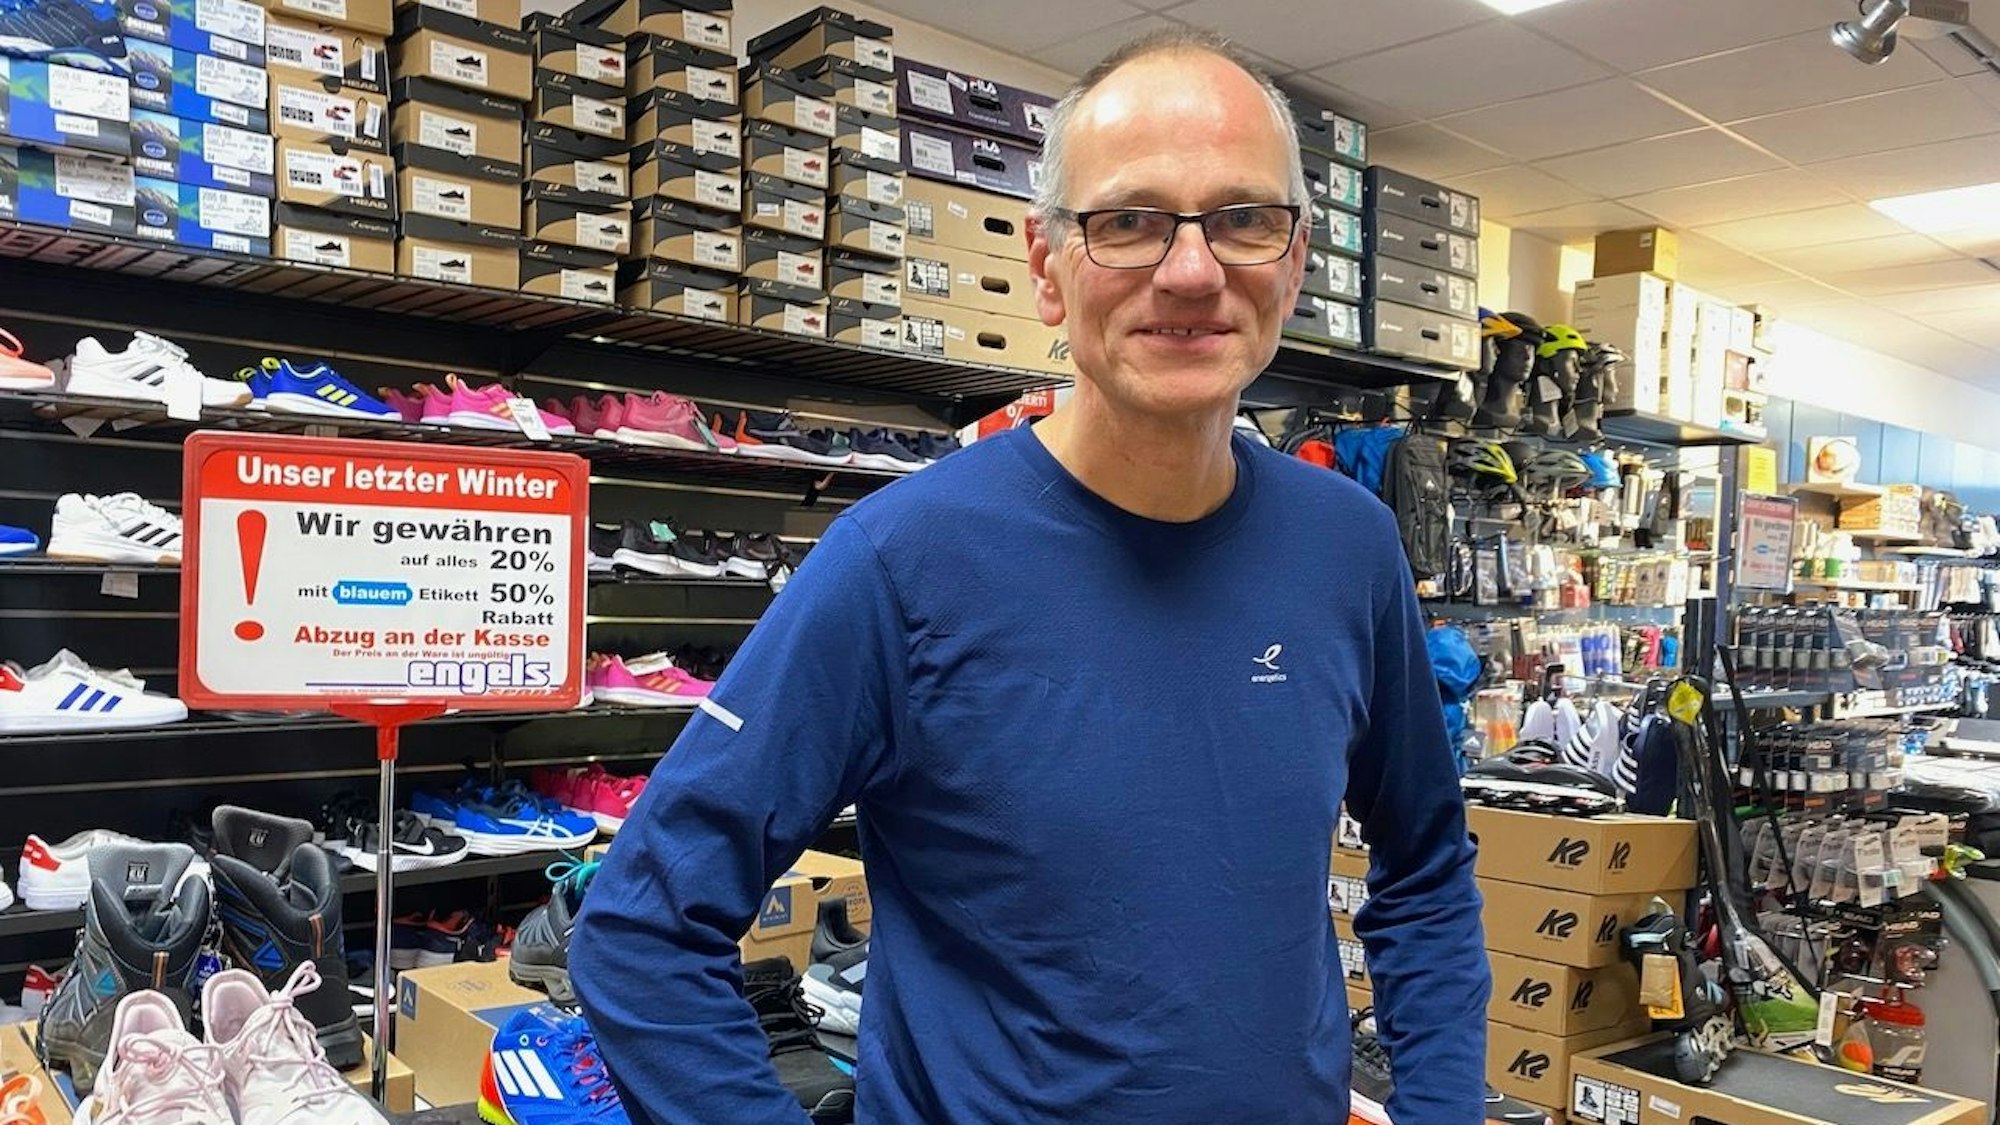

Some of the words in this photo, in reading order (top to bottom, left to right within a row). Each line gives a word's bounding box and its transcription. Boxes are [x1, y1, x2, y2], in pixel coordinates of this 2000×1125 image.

[969, 77, 997, 94] FILA
[344, 136, 383, 148] HEAD
[972, 138, 1000, 155] FILA
[349, 197, 388, 210] HEAD
[238, 455, 336, 488] Unser
[345, 461, 449, 494] letzter
[456, 467, 559, 500] Winter
[297, 511, 360, 537] Wir
[373, 518, 552, 545] gewähren
[400, 553, 429, 567] auf
[435, 555, 478, 568] alles
[490, 549, 554, 573] 20%
[299, 585, 328, 598] mit
[338, 585, 408, 602] blauem
[419, 587, 478, 602] Etikett
[490, 582, 554, 605] 50%
[482, 610, 554, 625] Rabatt
[294, 625, 375, 648] Abzug
[384, 632, 414, 645] an
[424, 627, 465, 646] der
[474, 629, 550, 647] Kasse
[333, 649, 352, 657] Der
[355, 649, 382, 657] Preis
[402, 650, 418, 658] der
[422, 650, 449, 658] Ware
[468, 651, 510, 660] ungültig
[408, 653, 551, 695] engels
[1547, 837, 1590, 866] K2
[1608, 841, 1631, 869] K2
[1535, 909, 1579, 938] K2
[1596, 914, 1617, 943] K2
[1510, 977, 1552, 1007] K2
[1571, 980, 1594, 1010] K2
[1507, 1050, 1550, 1080] K2
